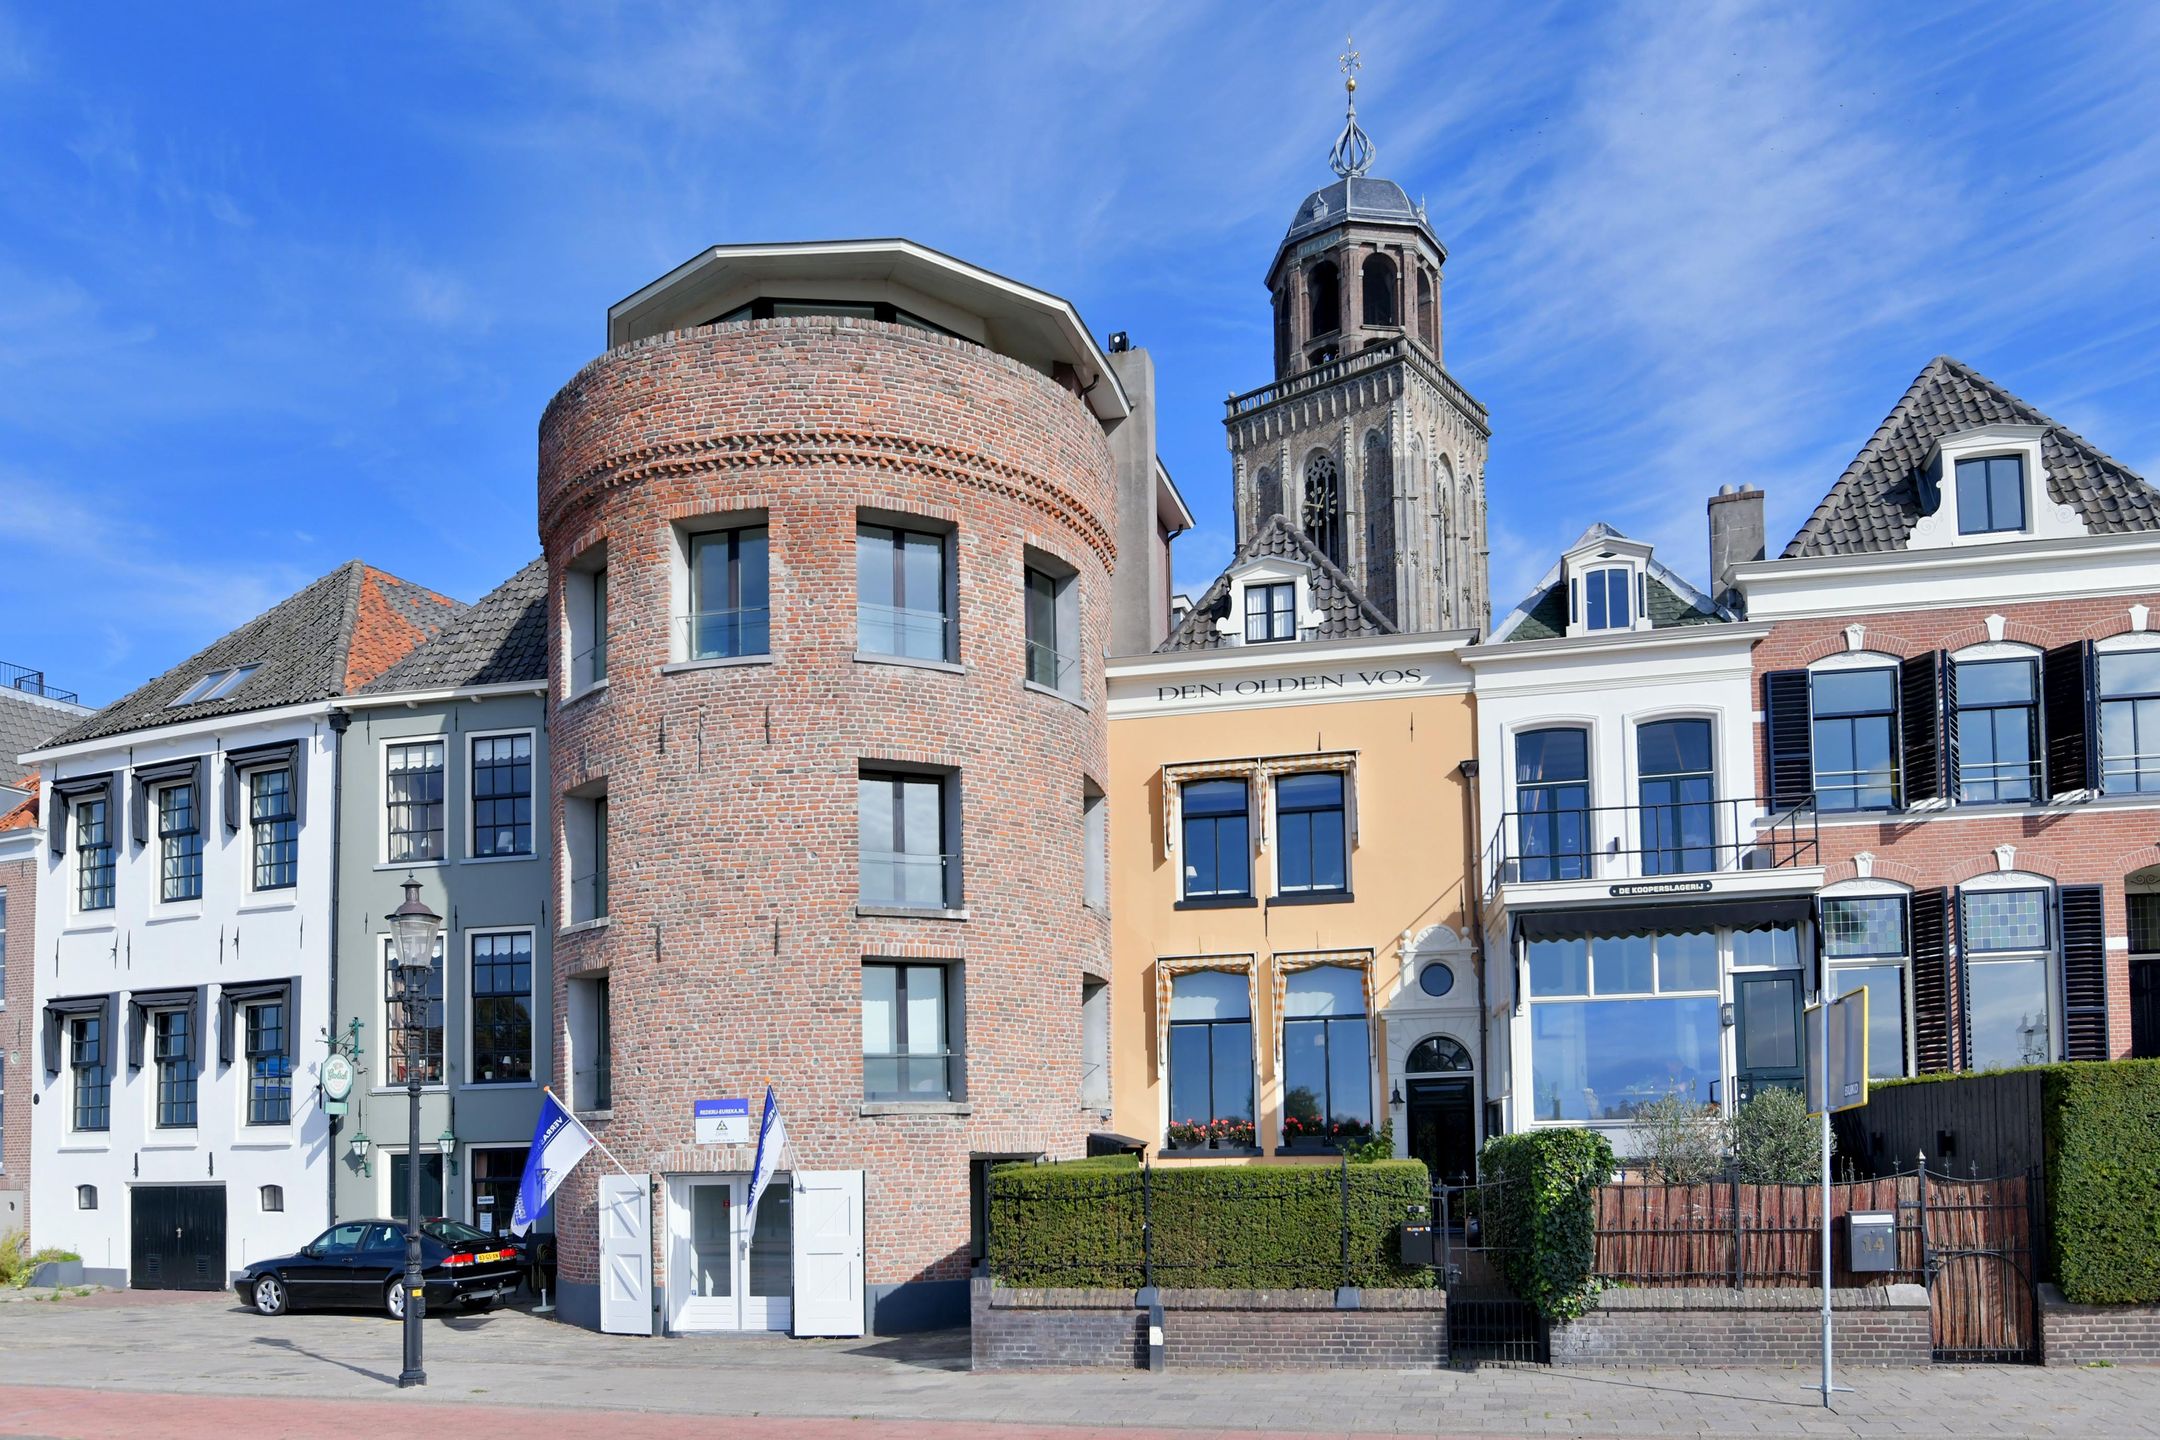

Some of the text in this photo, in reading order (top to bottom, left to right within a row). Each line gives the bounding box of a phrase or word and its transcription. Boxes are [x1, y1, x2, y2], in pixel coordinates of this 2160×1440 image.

[1157, 668, 1422, 701] DEN OLDEN VOS
[1618, 883, 1704, 895] DE KOOPERSLAGERIJ
